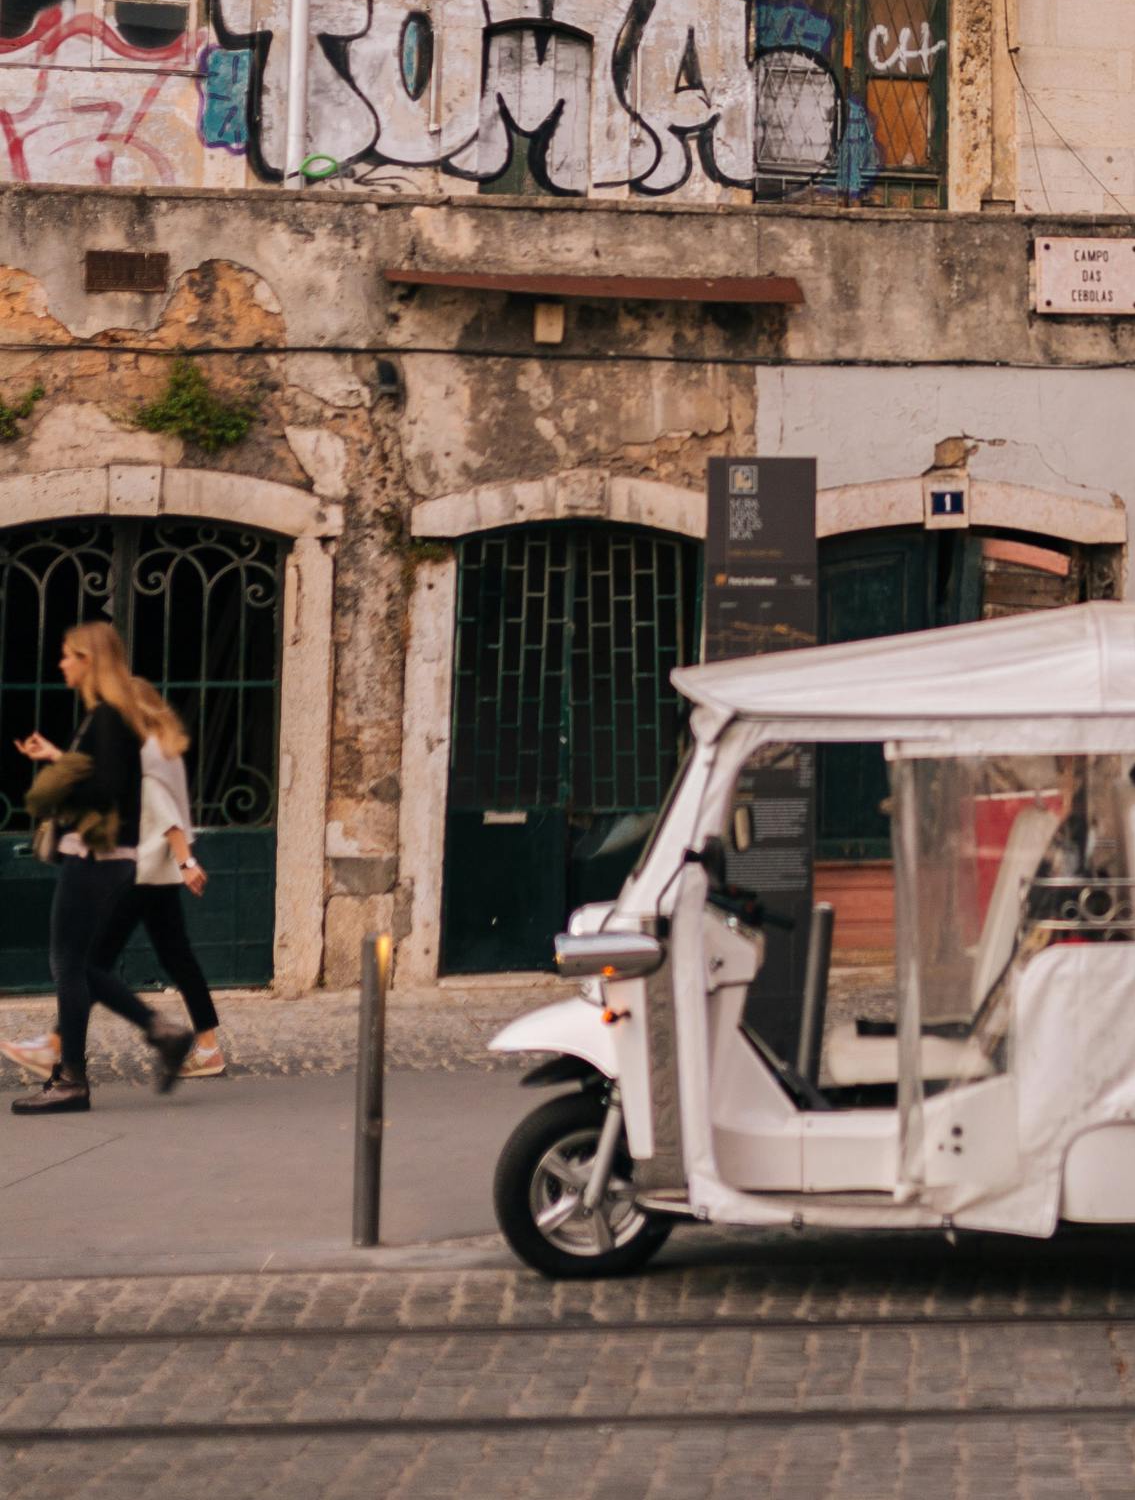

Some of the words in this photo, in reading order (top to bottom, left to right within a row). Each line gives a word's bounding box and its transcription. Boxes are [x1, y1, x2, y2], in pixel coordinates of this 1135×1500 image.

[1074, 249, 1109, 262] CAMPO
[1082, 270, 1102, 282] DAS
[1071, 290, 1113, 302] CEBOLAS
[944, 493, 953, 512] 1
